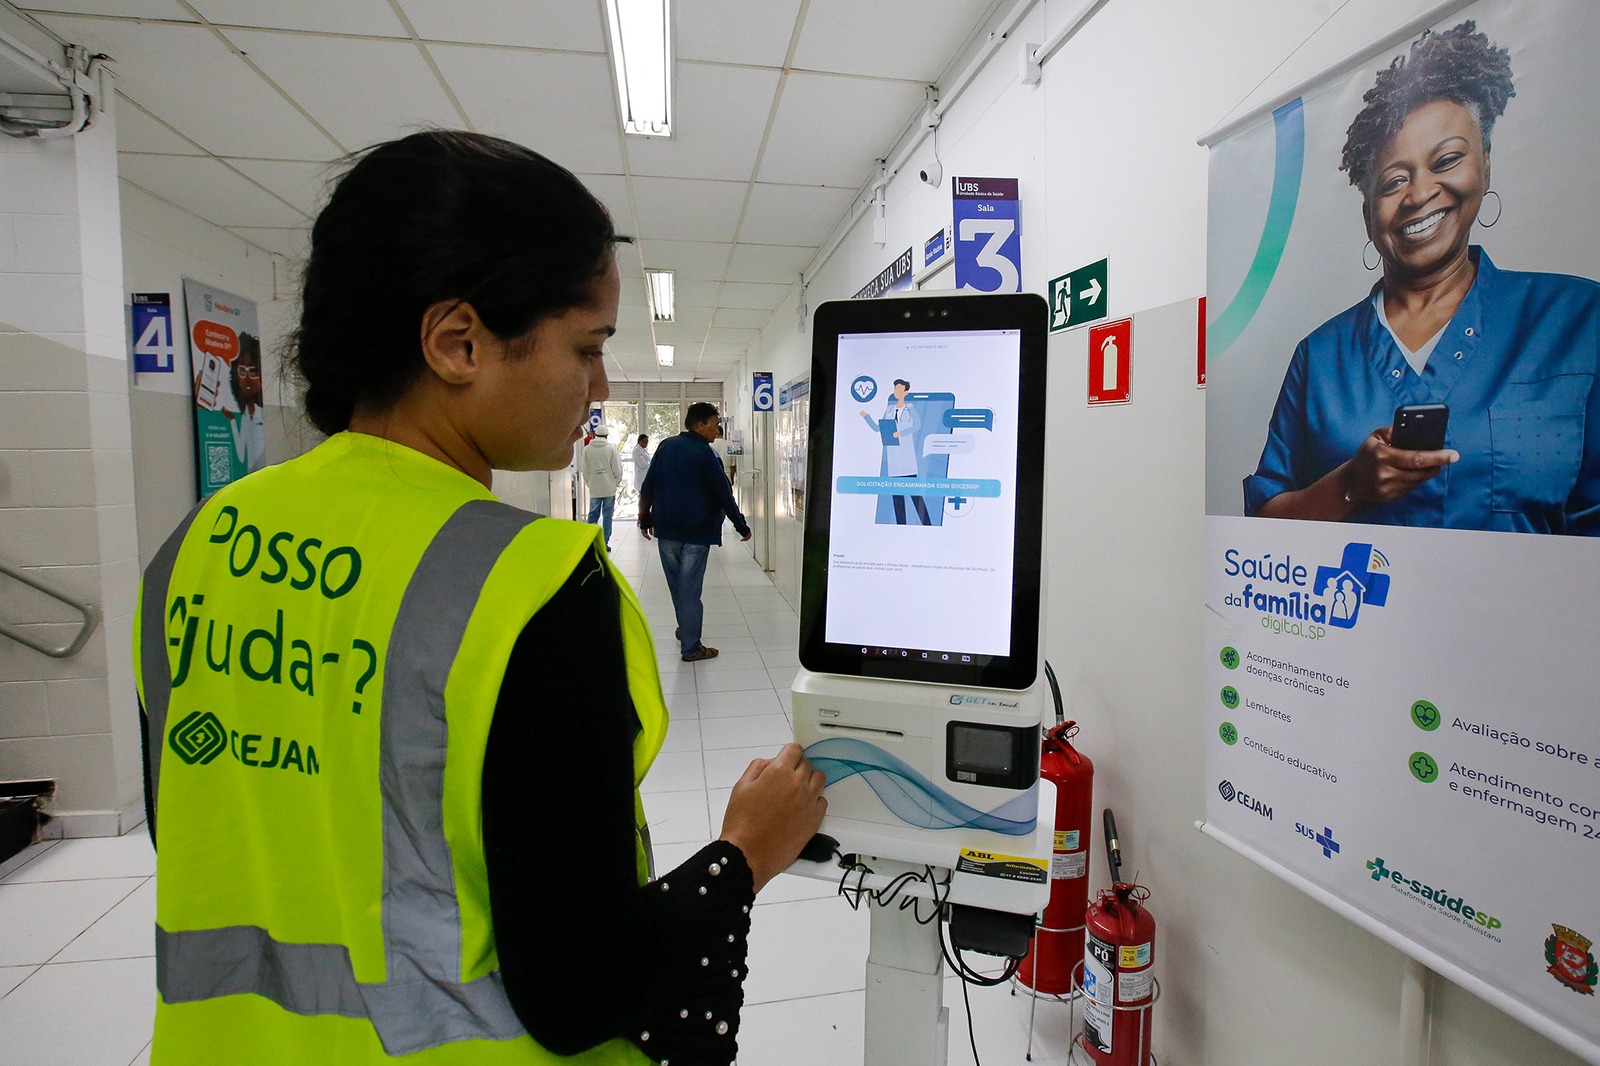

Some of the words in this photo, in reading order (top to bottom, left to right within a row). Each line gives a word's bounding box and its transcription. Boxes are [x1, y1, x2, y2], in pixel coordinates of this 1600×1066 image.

[960, 183, 978, 192] UBS
[880, 268, 894, 290] SUA
[896, 251, 911, 278] UBS
[959, 219, 1019, 292] 3
[135, 316, 172, 368] 4
[755, 383, 772, 410] 6
[1224, 548, 1308, 586] Saúde
[1224, 592, 1242, 607] da
[1242, 584, 1326, 624] família
[1246, 651, 1333, 684] Acompanhamento
[1336, 676, 1350, 688] de
[1246, 664, 1283, 683] doenças
[1284, 676, 1325, 696] crônicas
[966, 696, 986, 705] GET
[1246, 698, 1292, 723] Lembretes
[1243, 736, 1285, 762] Conteúdo
[1287, 755, 1338, 784] educativo
[1451, 717, 1531, 748] Avaliação
[1535, 740, 1588, 765] sobre
[1449, 762, 1564, 808] Atendimento
[1237, 791, 1273, 821] CEJAM
[1449, 781, 1458, 791] e
[1462, 787, 1577, 833] enfermagem
[1295, 822, 1315, 840] SUS
[966, 850, 995, 860] ABL
[1390, 883, 1426, 906] Plataforma
[1428, 902, 1437, 911] da
[1438, 907, 1461, 923] Saúde
[1462, 920, 1502, 944] Paulistana
[1391, 870, 1502, 930] e-saúdeSP
[1094, 946, 1109, 961] PÓ
